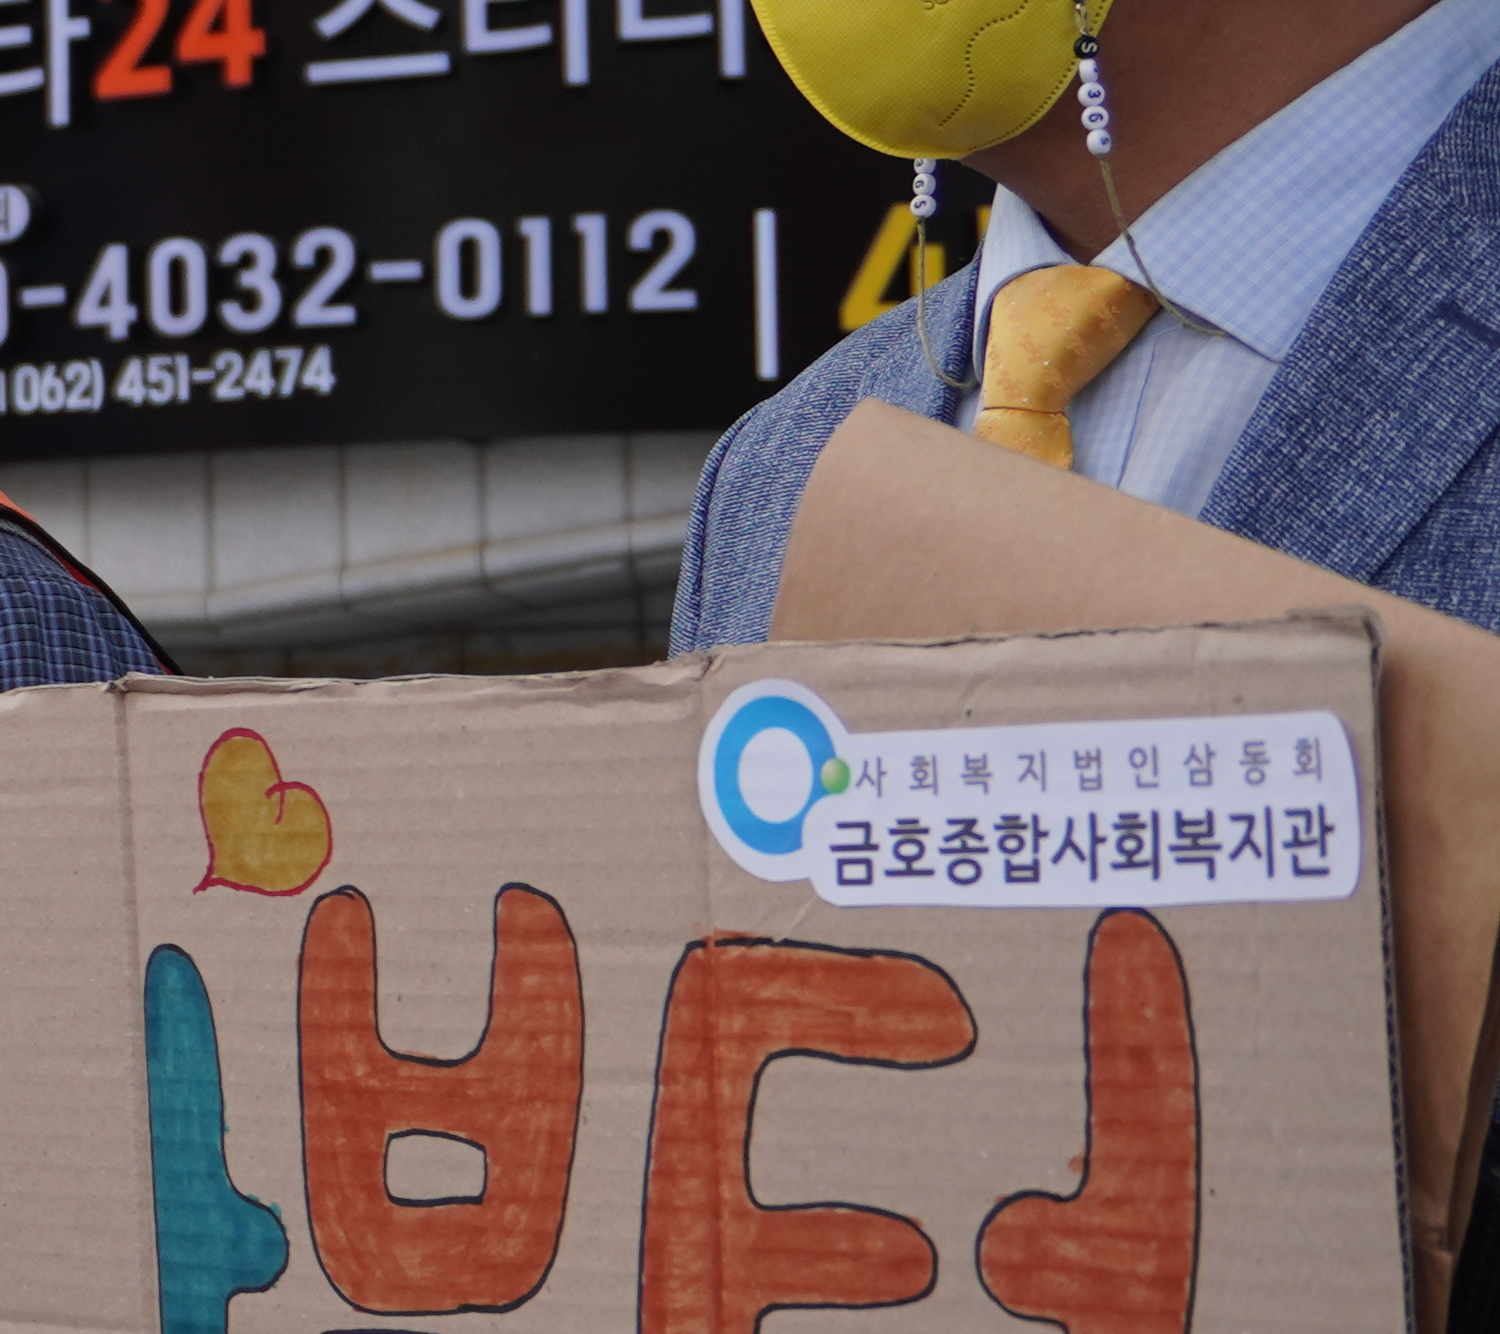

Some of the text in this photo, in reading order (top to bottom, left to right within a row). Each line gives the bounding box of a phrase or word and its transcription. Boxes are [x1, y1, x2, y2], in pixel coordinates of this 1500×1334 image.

[12, 357, 105, 415] 062)
[115, 345, 336, 407] 451-2474
[828, 803, 1335, 887] 금호종합사회복지관
